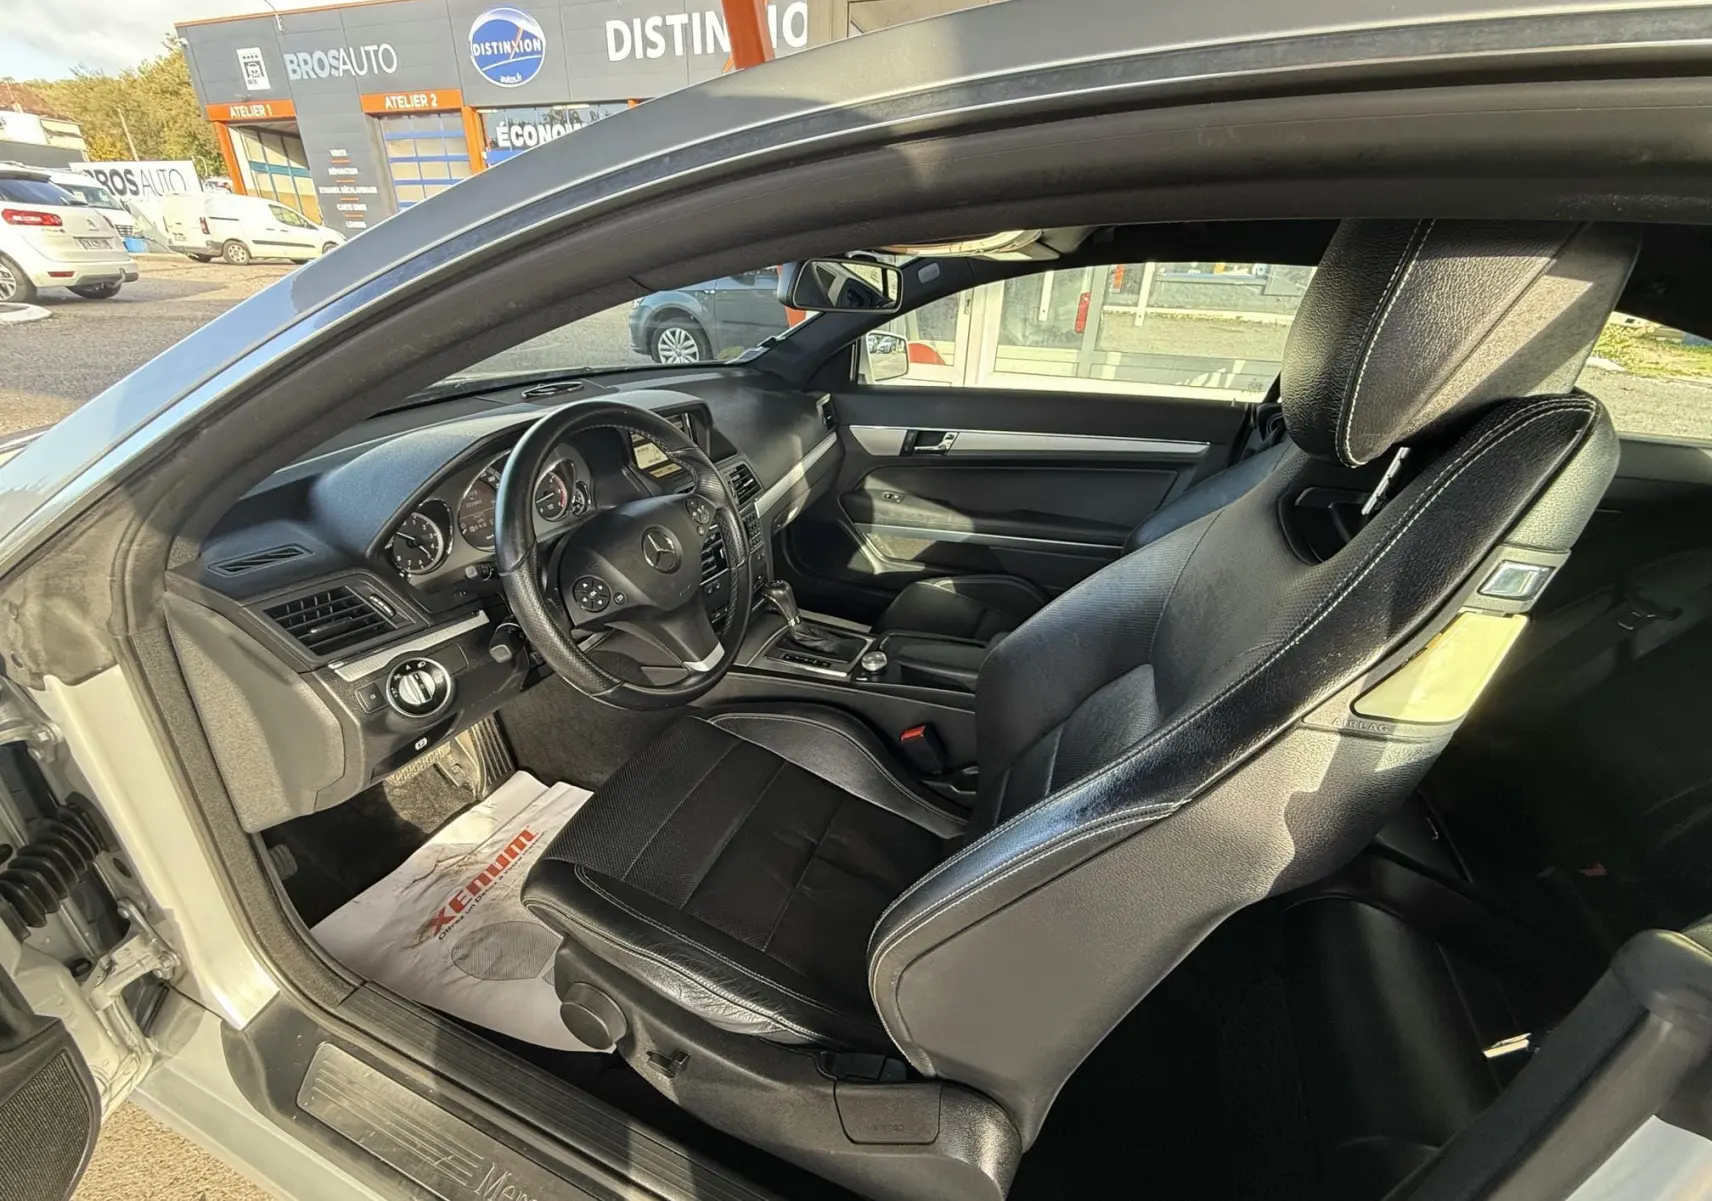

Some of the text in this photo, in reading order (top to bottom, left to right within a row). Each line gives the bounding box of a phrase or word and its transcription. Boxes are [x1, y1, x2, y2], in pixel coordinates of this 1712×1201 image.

[472, 38, 542, 57] DISTINXION
[283, 43, 398, 80] BROSAUTO
[385, 93, 438, 109] ATELIER 2
[230, 105, 266, 118] ATELIER
[1331, 717, 1389, 733] AIRBAG
